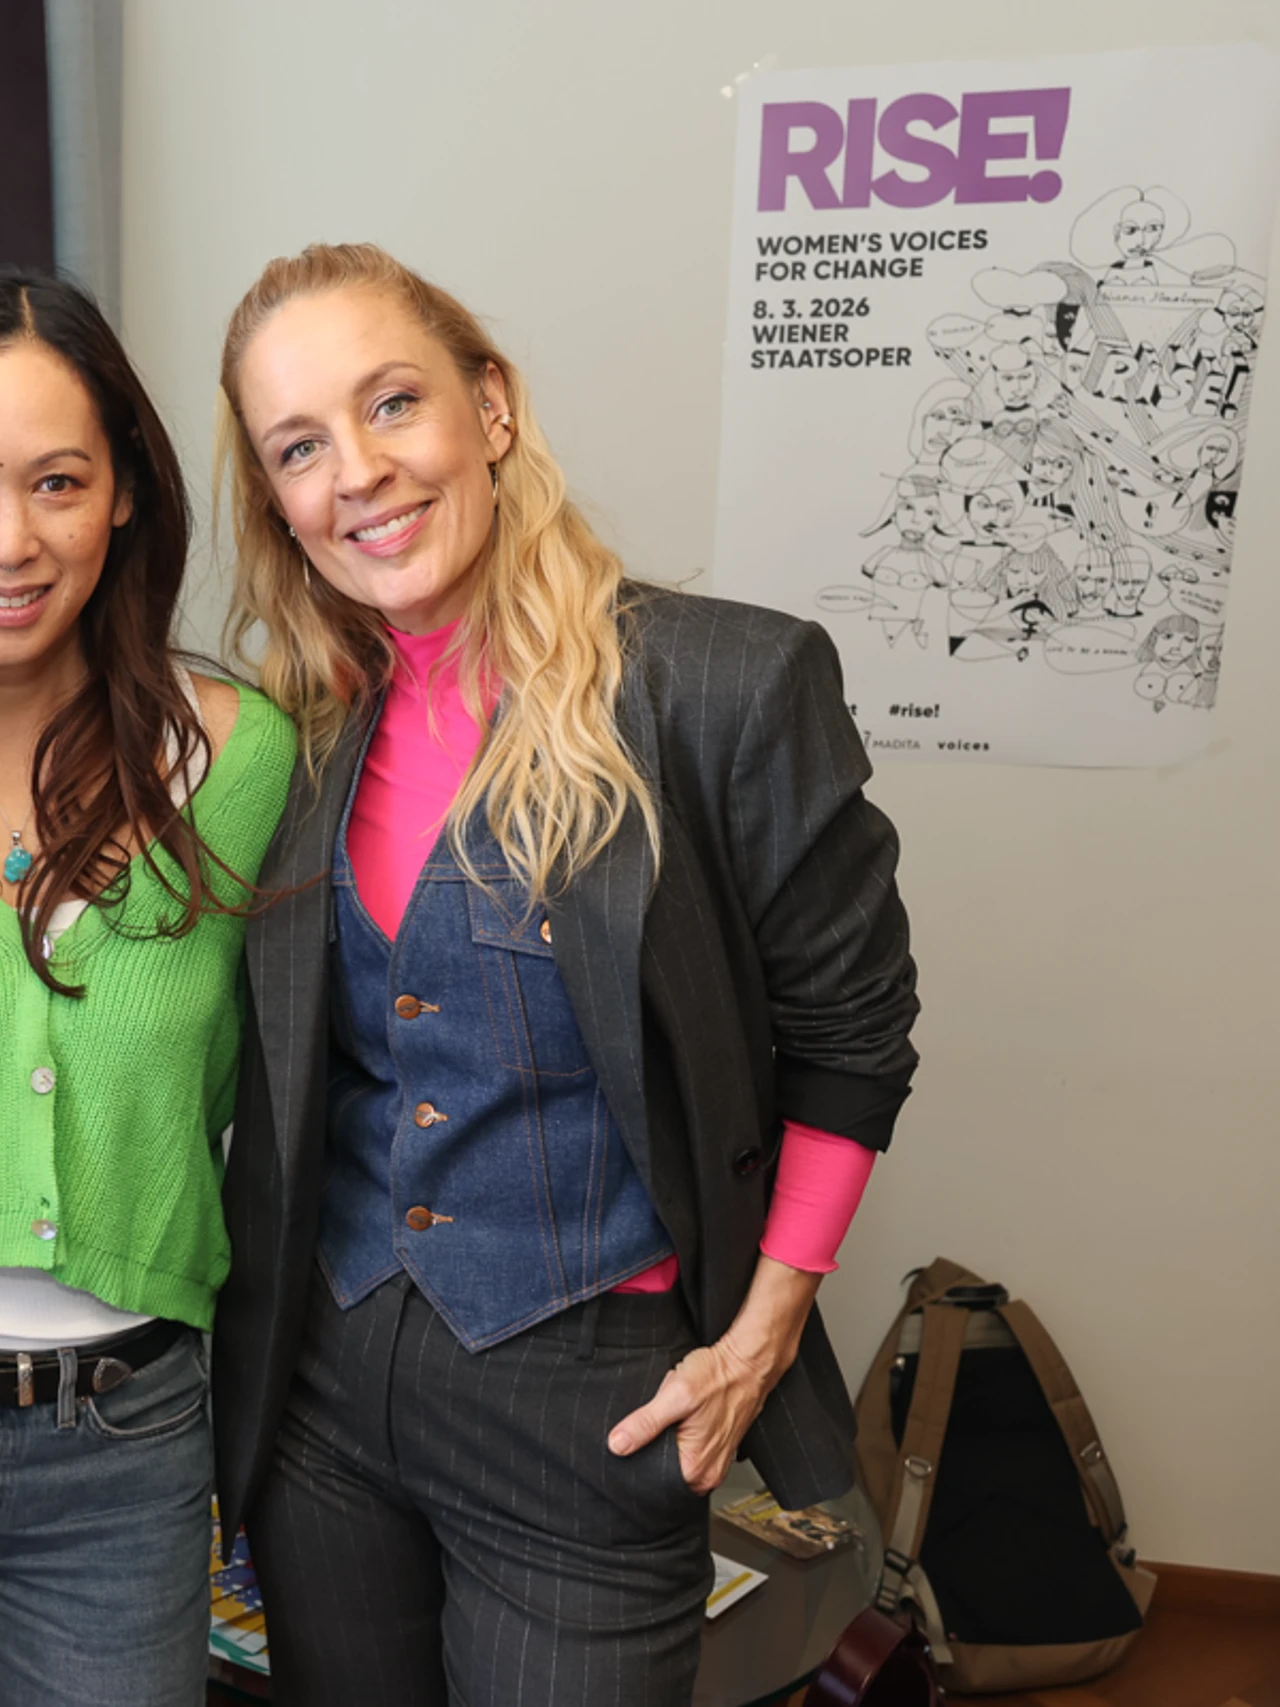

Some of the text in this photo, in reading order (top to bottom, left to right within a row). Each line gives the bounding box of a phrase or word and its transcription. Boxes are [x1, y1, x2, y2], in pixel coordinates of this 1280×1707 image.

[757, 87, 1071, 212] RISE!
[757, 229, 988, 256] WOMEN'S VOICES
[755, 257, 924, 281] FOR CHANGE
[753, 297, 870, 319] 8. 3. 2026
[752, 323, 849, 344] WIENER
[751, 347, 912, 368] STAATSOPER
[1086, 345, 1251, 420] RISE!
[889, 702, 940, 718] #rise!
[872, 738, 990, 751] MADITA voices
